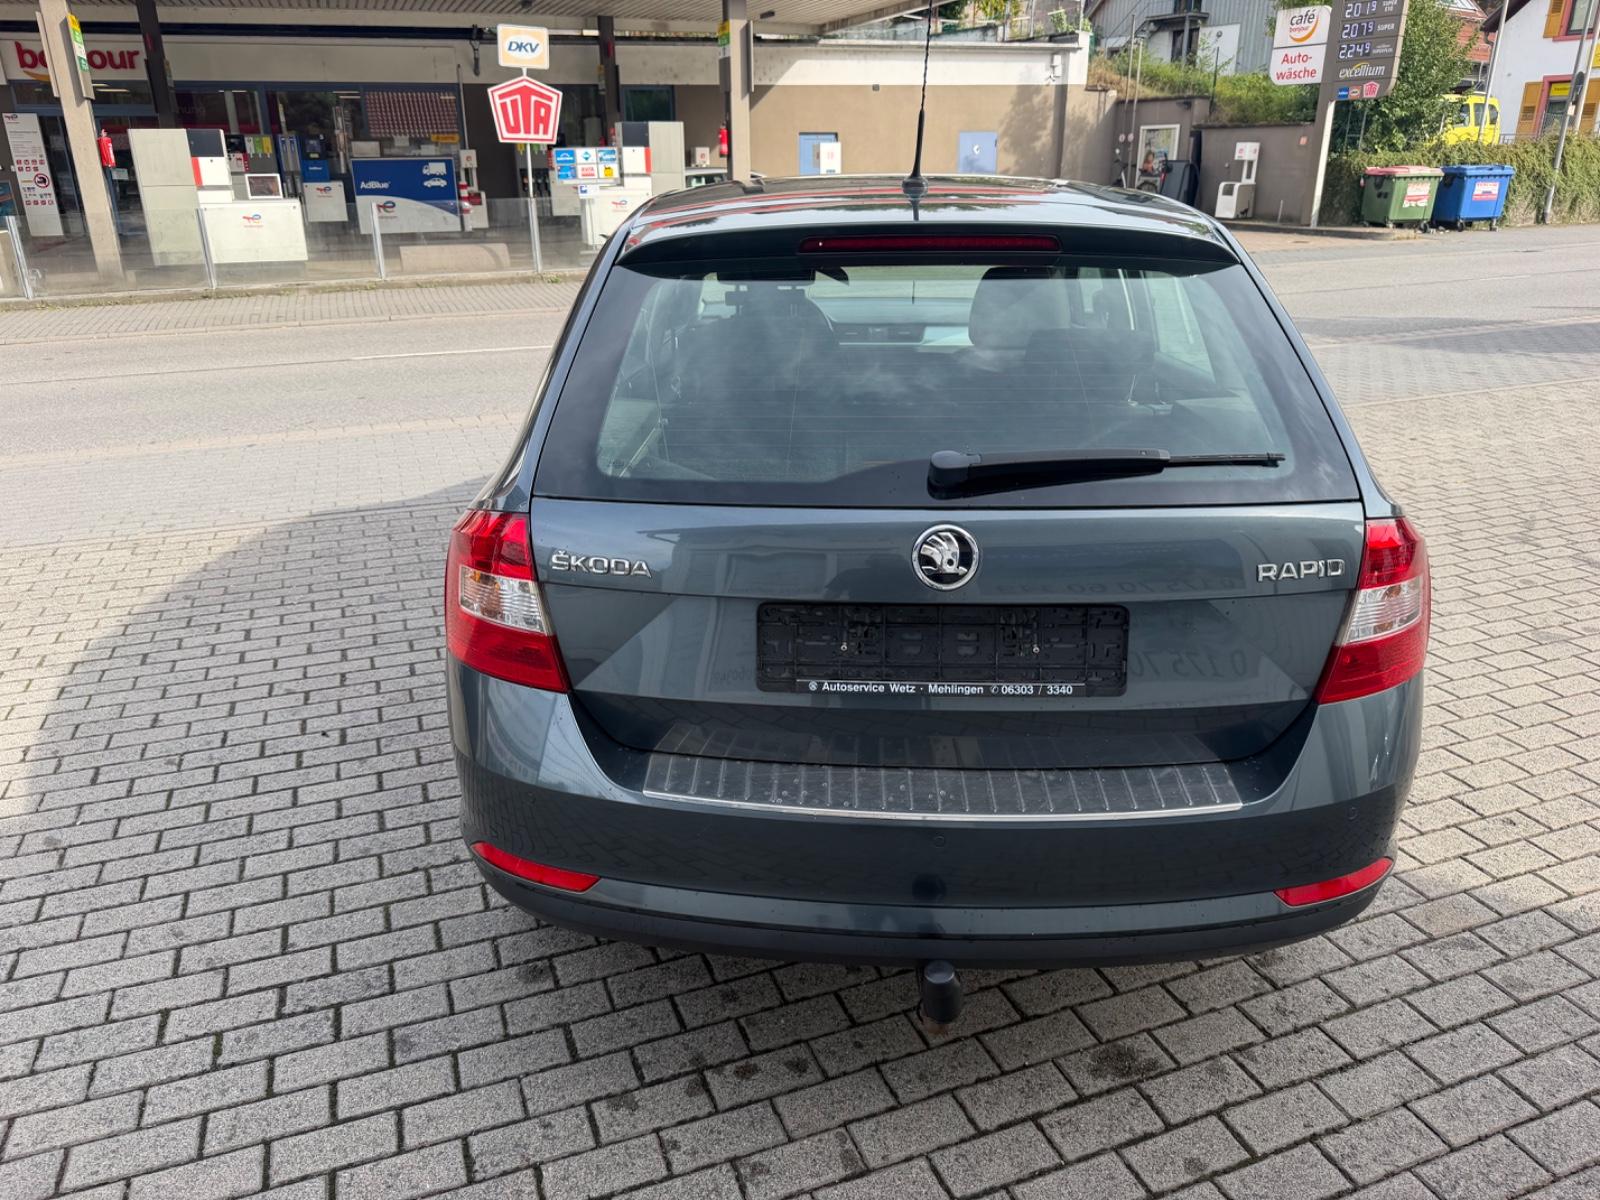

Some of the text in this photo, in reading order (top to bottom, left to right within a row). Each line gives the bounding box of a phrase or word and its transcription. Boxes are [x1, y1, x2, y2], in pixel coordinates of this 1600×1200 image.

[1290, 9, 1315, 26] café
[1377, 23, 1395, 31] SUPER
[508, 41, 540, 53] DKV
[1281, 52, 1312, 65] Auto-
[1276, 67, 1317, 81] wäsche
[1339, 64, 1385, 78] excellium
[498, 85, 554, 136] UTA
[360, 180, 390, 189] AdBlue
[551, 550, 652, 579] ŠKODA
[1257, 559, 1345, 582] RAPID
[822, 682, 885, 693] Autoservice
[889, 683, 916, 693] Wetz
[928, 684, 984, 695] Mehlingen
[1001, 685, 1034, 695] 06303
[1046, 685, 1073, 695] 3340
